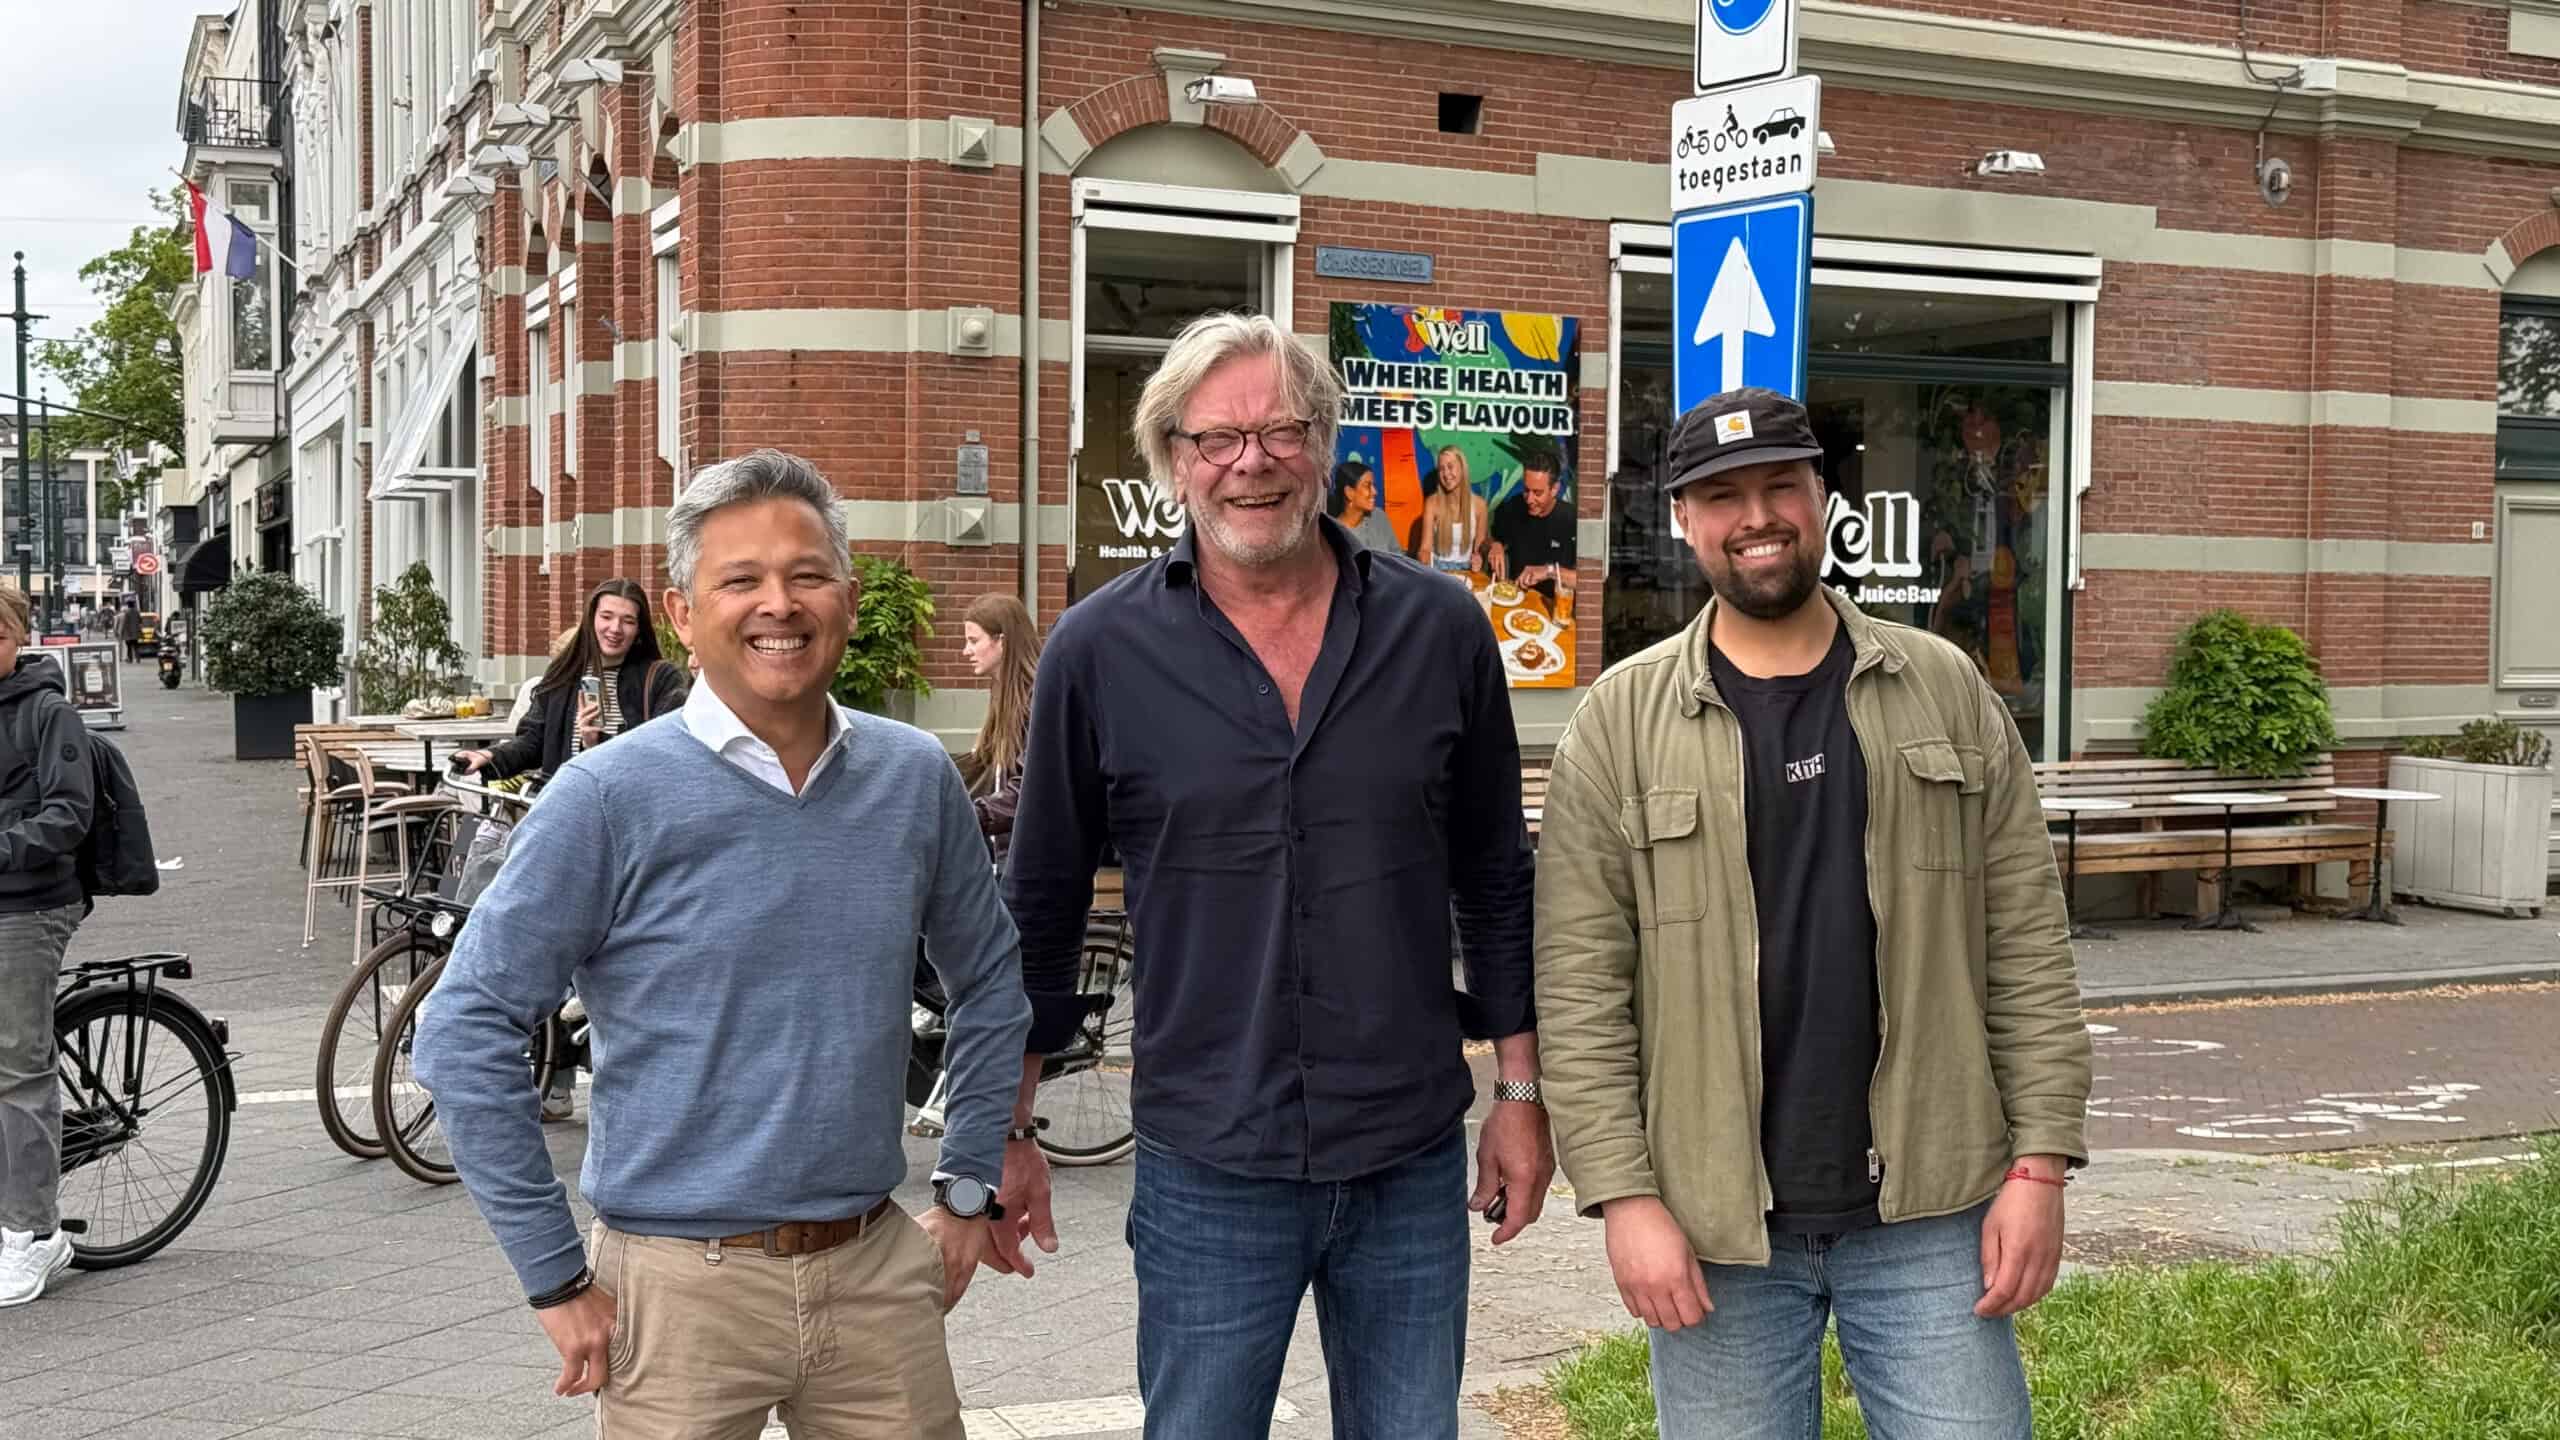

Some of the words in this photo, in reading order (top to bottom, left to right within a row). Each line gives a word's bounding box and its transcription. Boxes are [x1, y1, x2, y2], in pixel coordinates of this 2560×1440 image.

[1679, 153, 1802, 192] toegestaan
[1426, 320, 1489, 356] Well
[1343, 358, 1449, 391] WHERE
[1457, 368, 1564, 397] HEALTH
[1341, 396, 1435, 424] MEETS
[1442, 402, 1570, 431] FLAVOUR
[1102, 479, 1186, 538] We
[1099, 545, 1148, 559] Health
[1150, 546, 1163, 559] &
[1820, 490, 1922, 578] ell
[1854, 585, 1942, 603] JuiceBar
[1785, 752, 1826, 783] KITH
